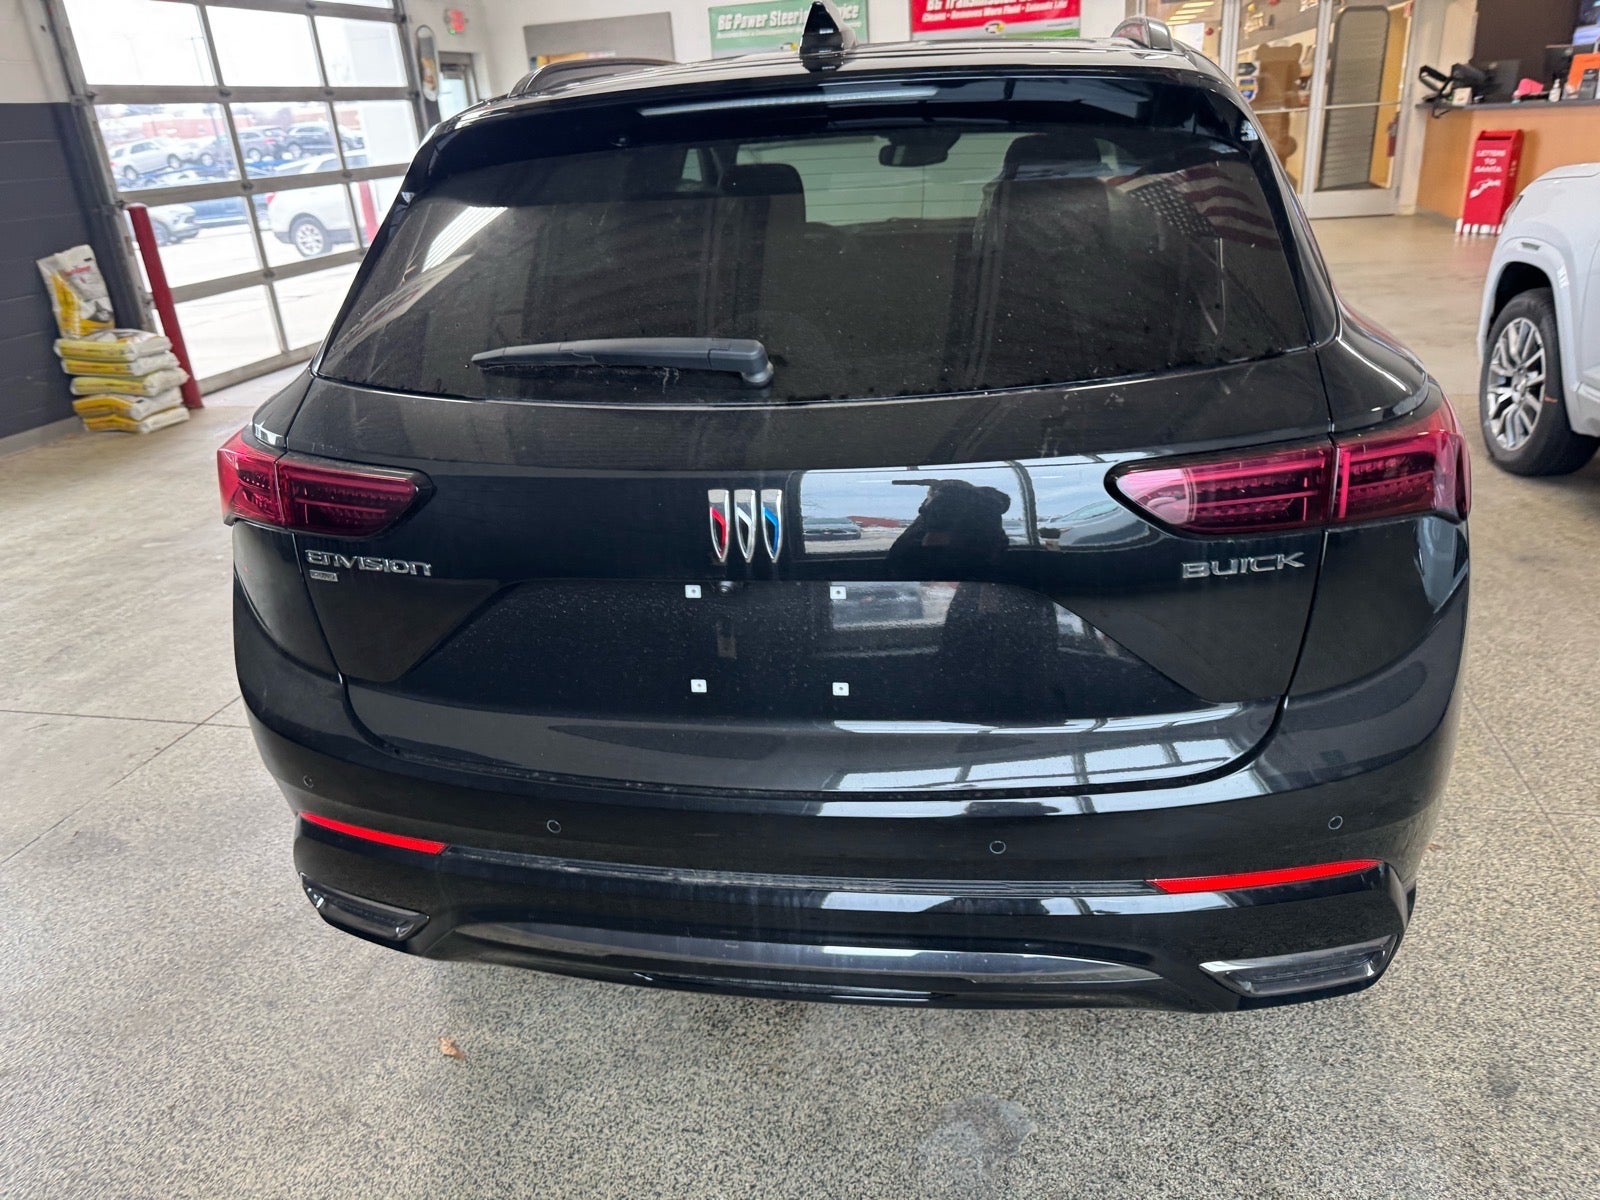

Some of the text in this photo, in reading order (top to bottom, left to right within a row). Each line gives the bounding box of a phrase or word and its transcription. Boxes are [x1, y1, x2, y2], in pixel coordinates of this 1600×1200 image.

[733, 10, 768, 29] Power
[769, 5, 809, 28] Steeri
[304, 549, 432, 576] ENVISION
[1181, 551, 1305, 579] BUICK
